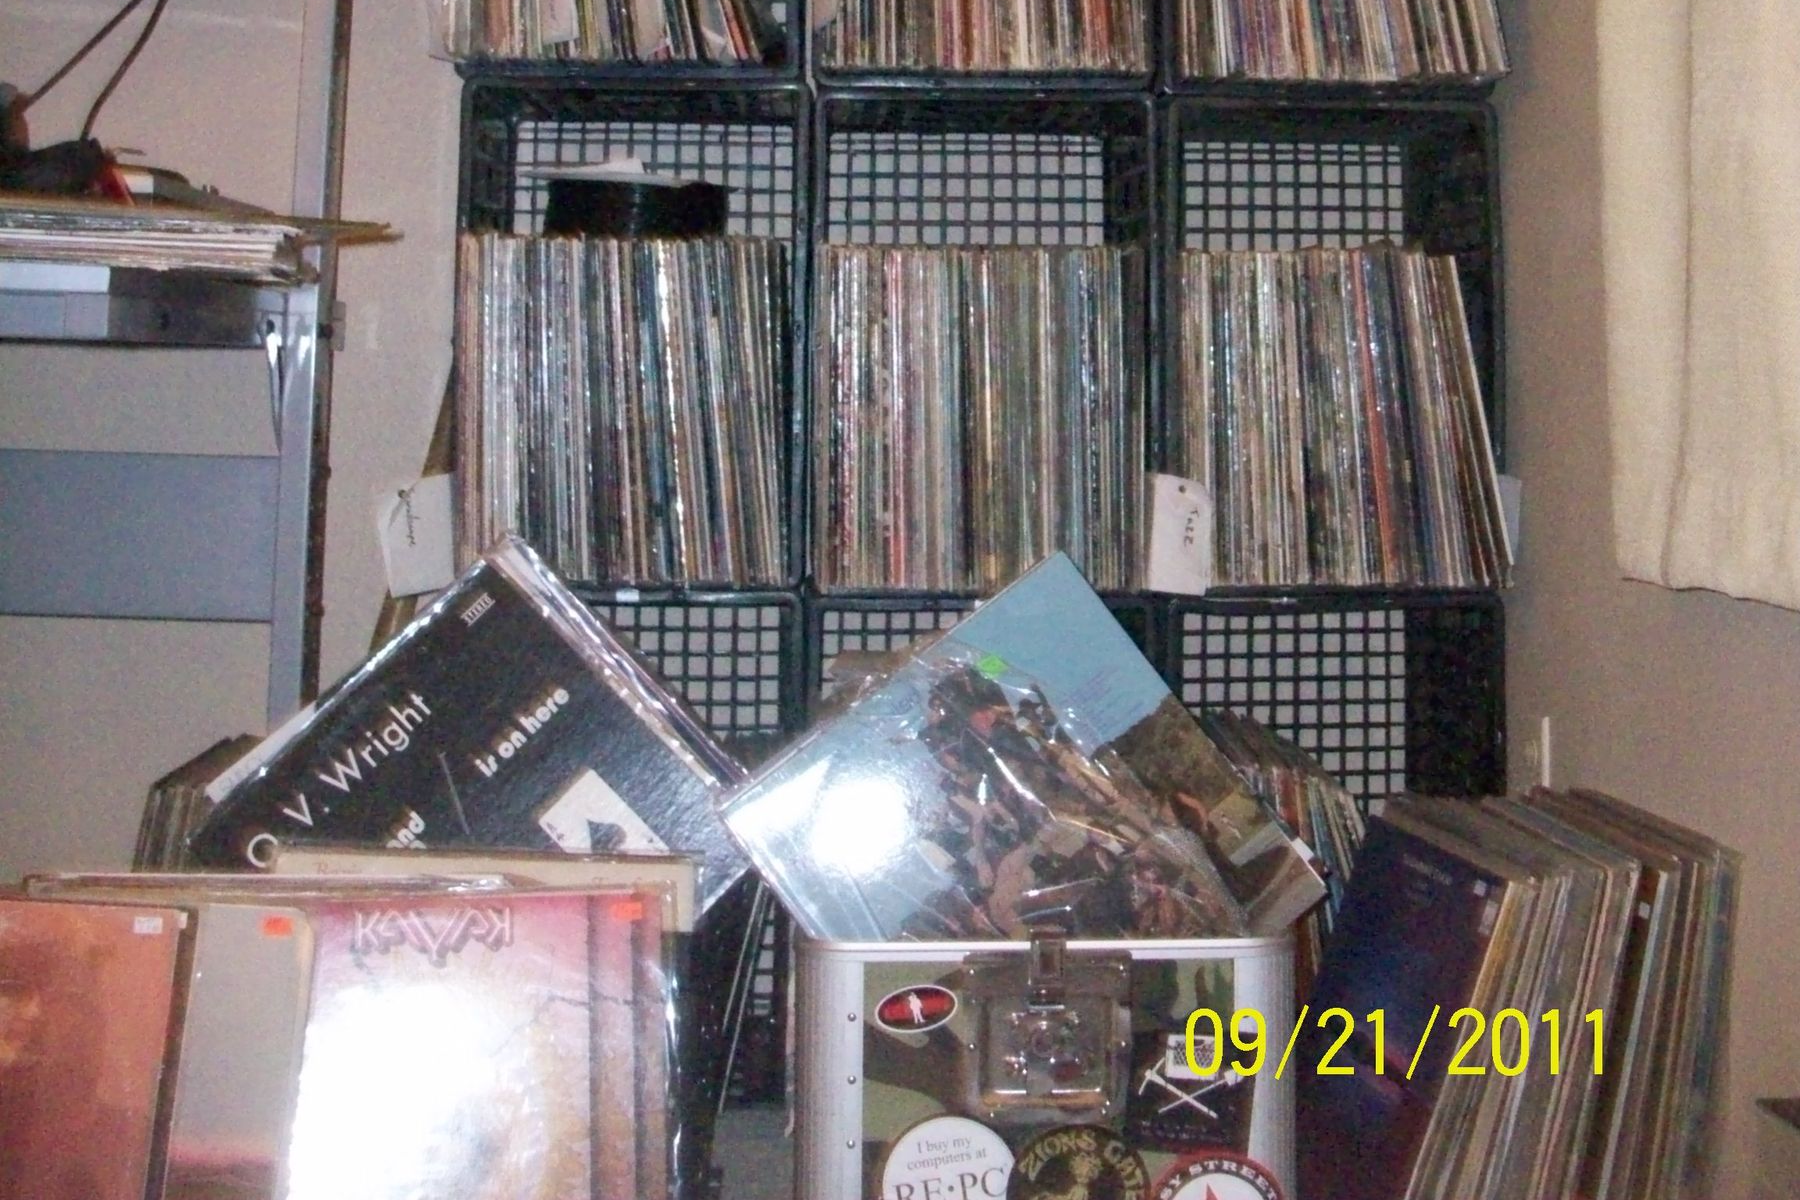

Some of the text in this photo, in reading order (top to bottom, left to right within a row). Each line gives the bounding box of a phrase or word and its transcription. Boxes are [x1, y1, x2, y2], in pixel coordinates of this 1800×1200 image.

[319, 693, 432, 792] Wright
[474, 688, 570, 777] is on here
[907, 1147, 987, 1170] computers at
[926, 1140, 948, 1154] buy
[953, 1137, 971, 1149] my
